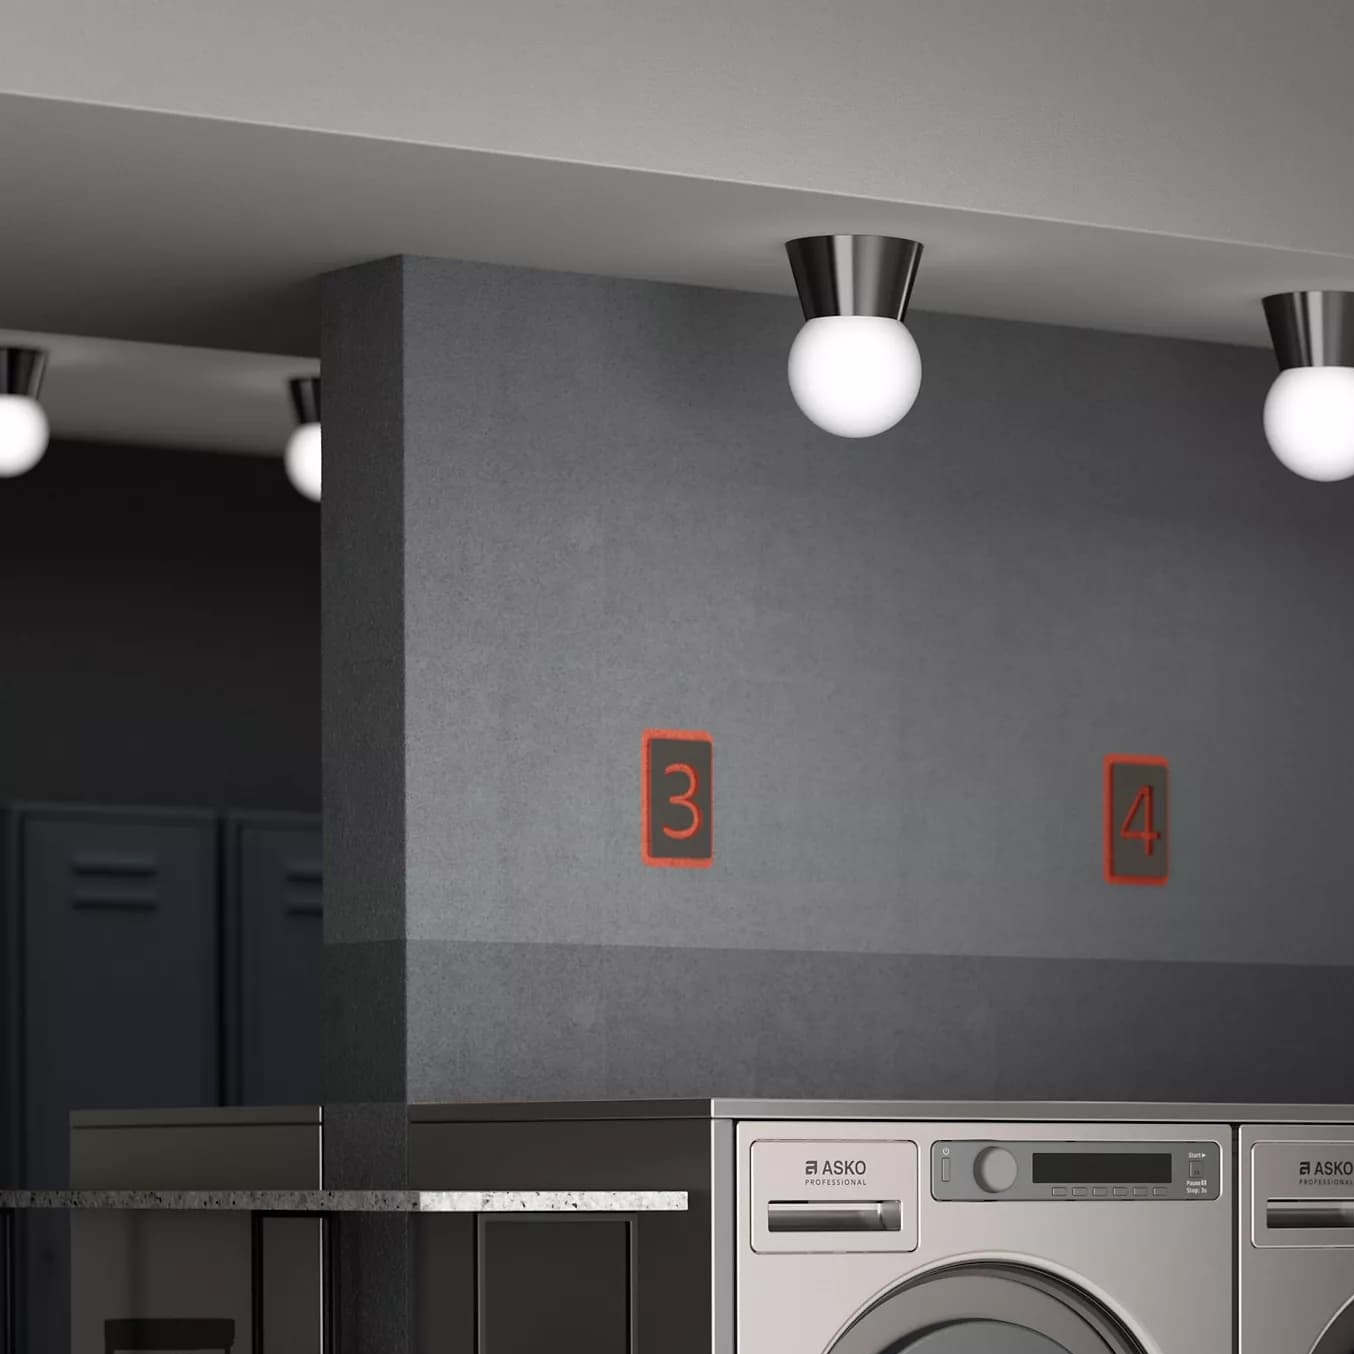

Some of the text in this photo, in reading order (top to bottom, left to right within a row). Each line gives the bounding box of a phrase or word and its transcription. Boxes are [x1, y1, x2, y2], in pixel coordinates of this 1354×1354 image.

[664, 763, 702, 840] 3
[1121, 784, 1161, 856] 4
[822, 1160, 866, 1175] ASKO
[1314, 1161, 1353, 1176] ASKO
